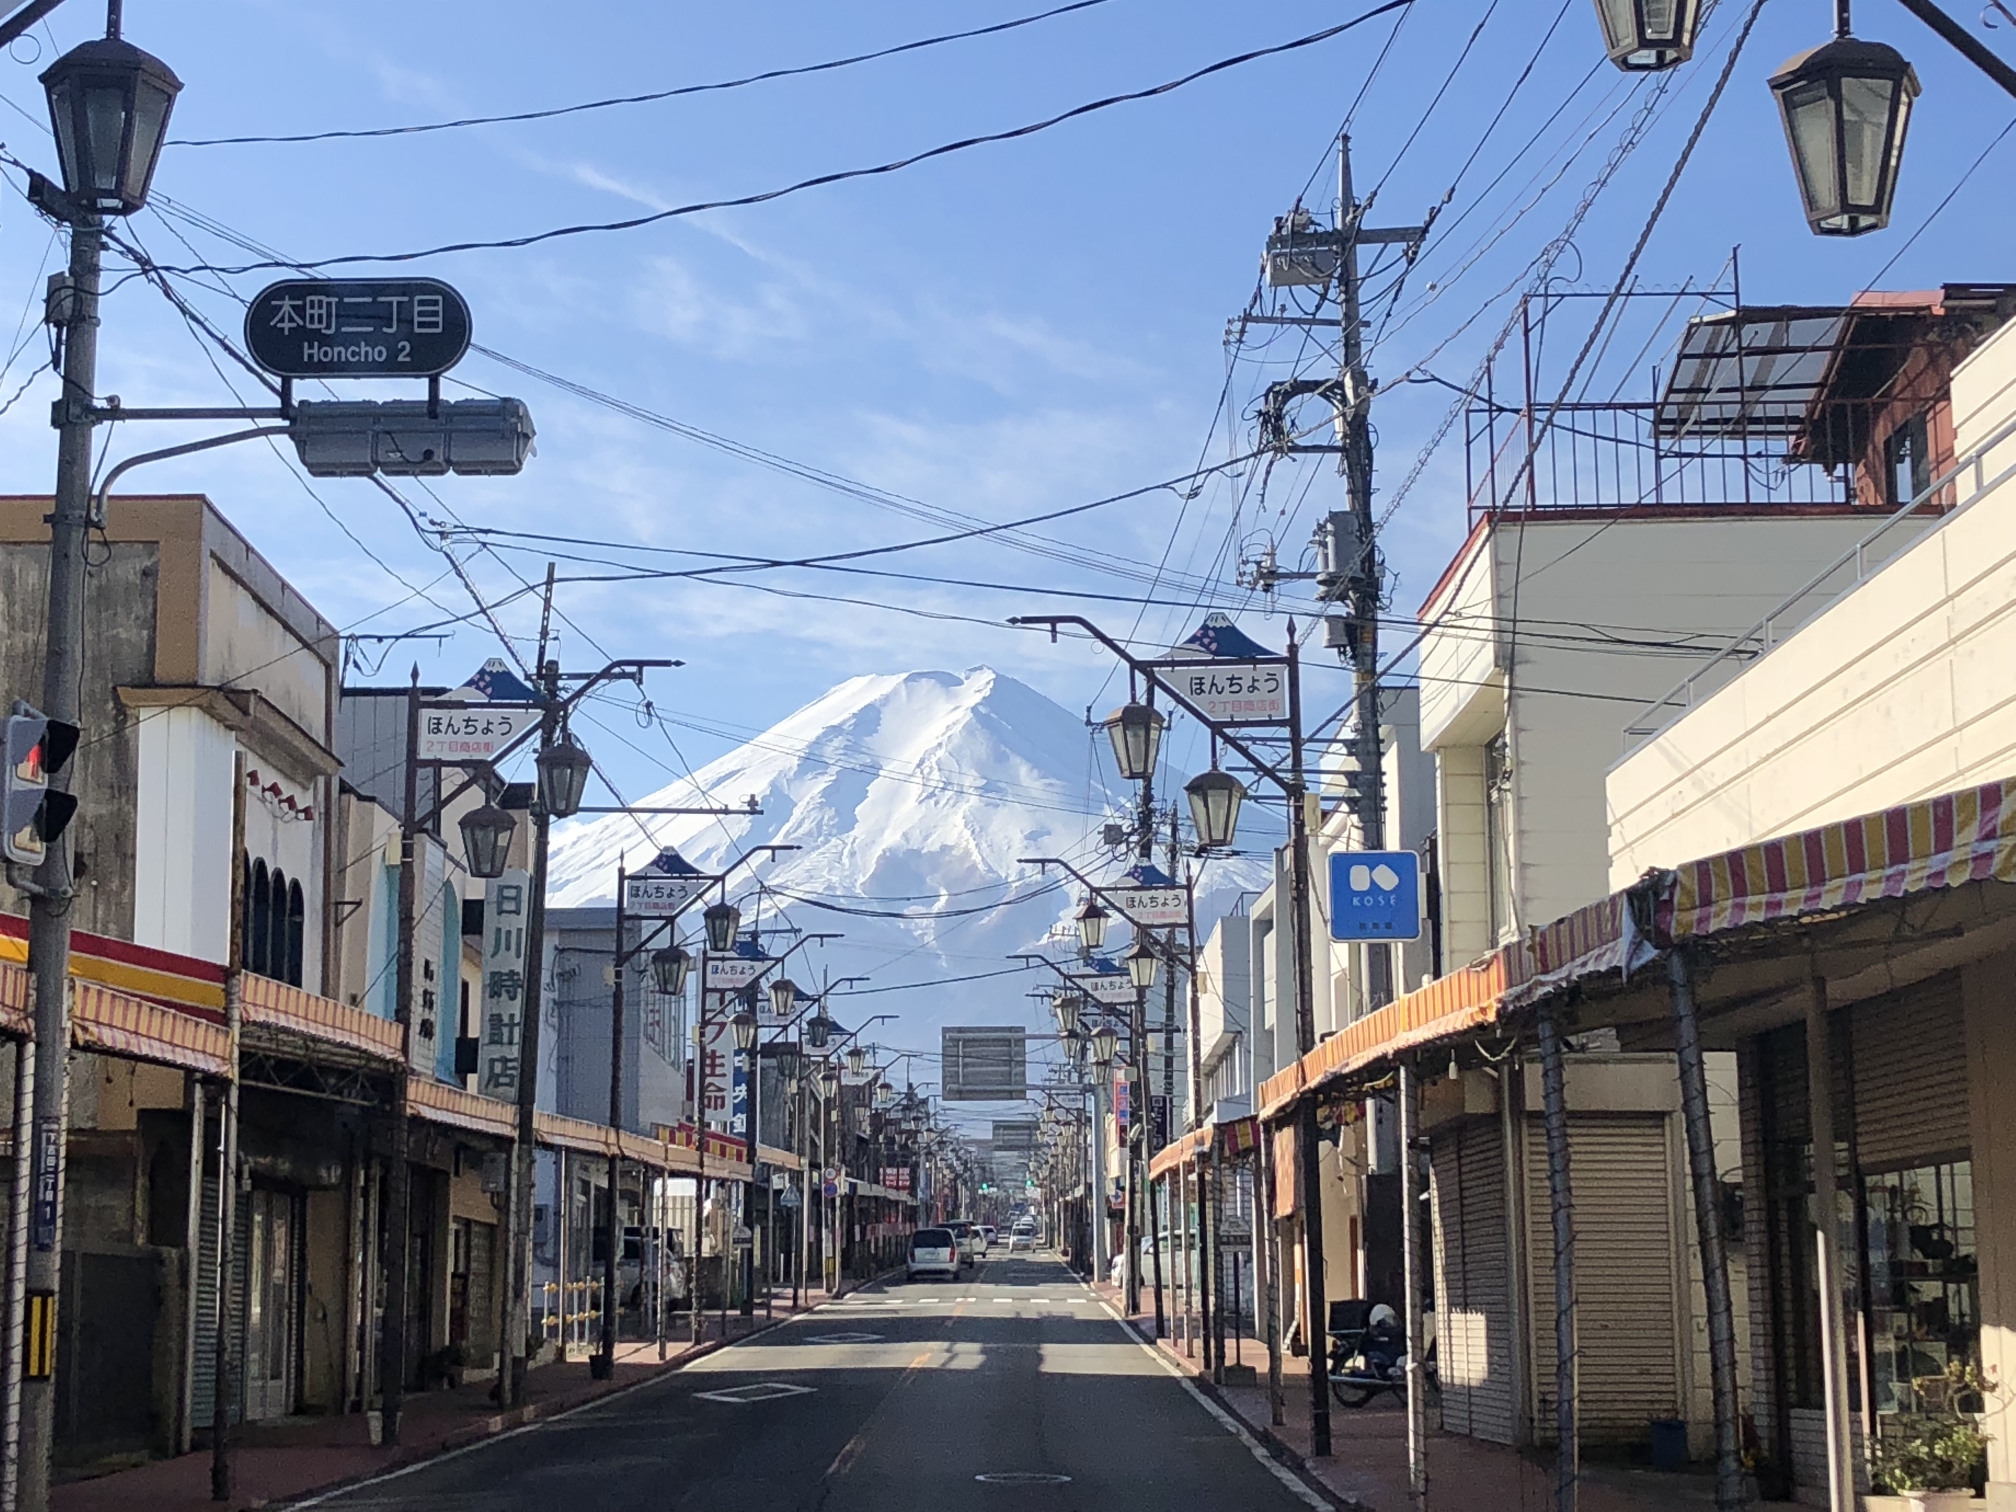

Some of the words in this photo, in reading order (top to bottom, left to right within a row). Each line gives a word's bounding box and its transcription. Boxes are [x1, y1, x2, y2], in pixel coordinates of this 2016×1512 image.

[270, 295, 443, 336] 本町二丁目
[303, 341, 387, 362] Honcho
[397, 341, 412, 362] 2
[1190, 672, 1280, 696] ほんちょう
[1208, 699, 1280, 713] 2丁目商店街
[427, 715, 513, 736] ほんちょう
[426, 741, 494, 753] 2丁目商店街
[630, 884, 688, 899] ほんちょう
[1125, 894, 1182, 909] ほんちょう
[485, 884, 524, 1089] 日川時計店
